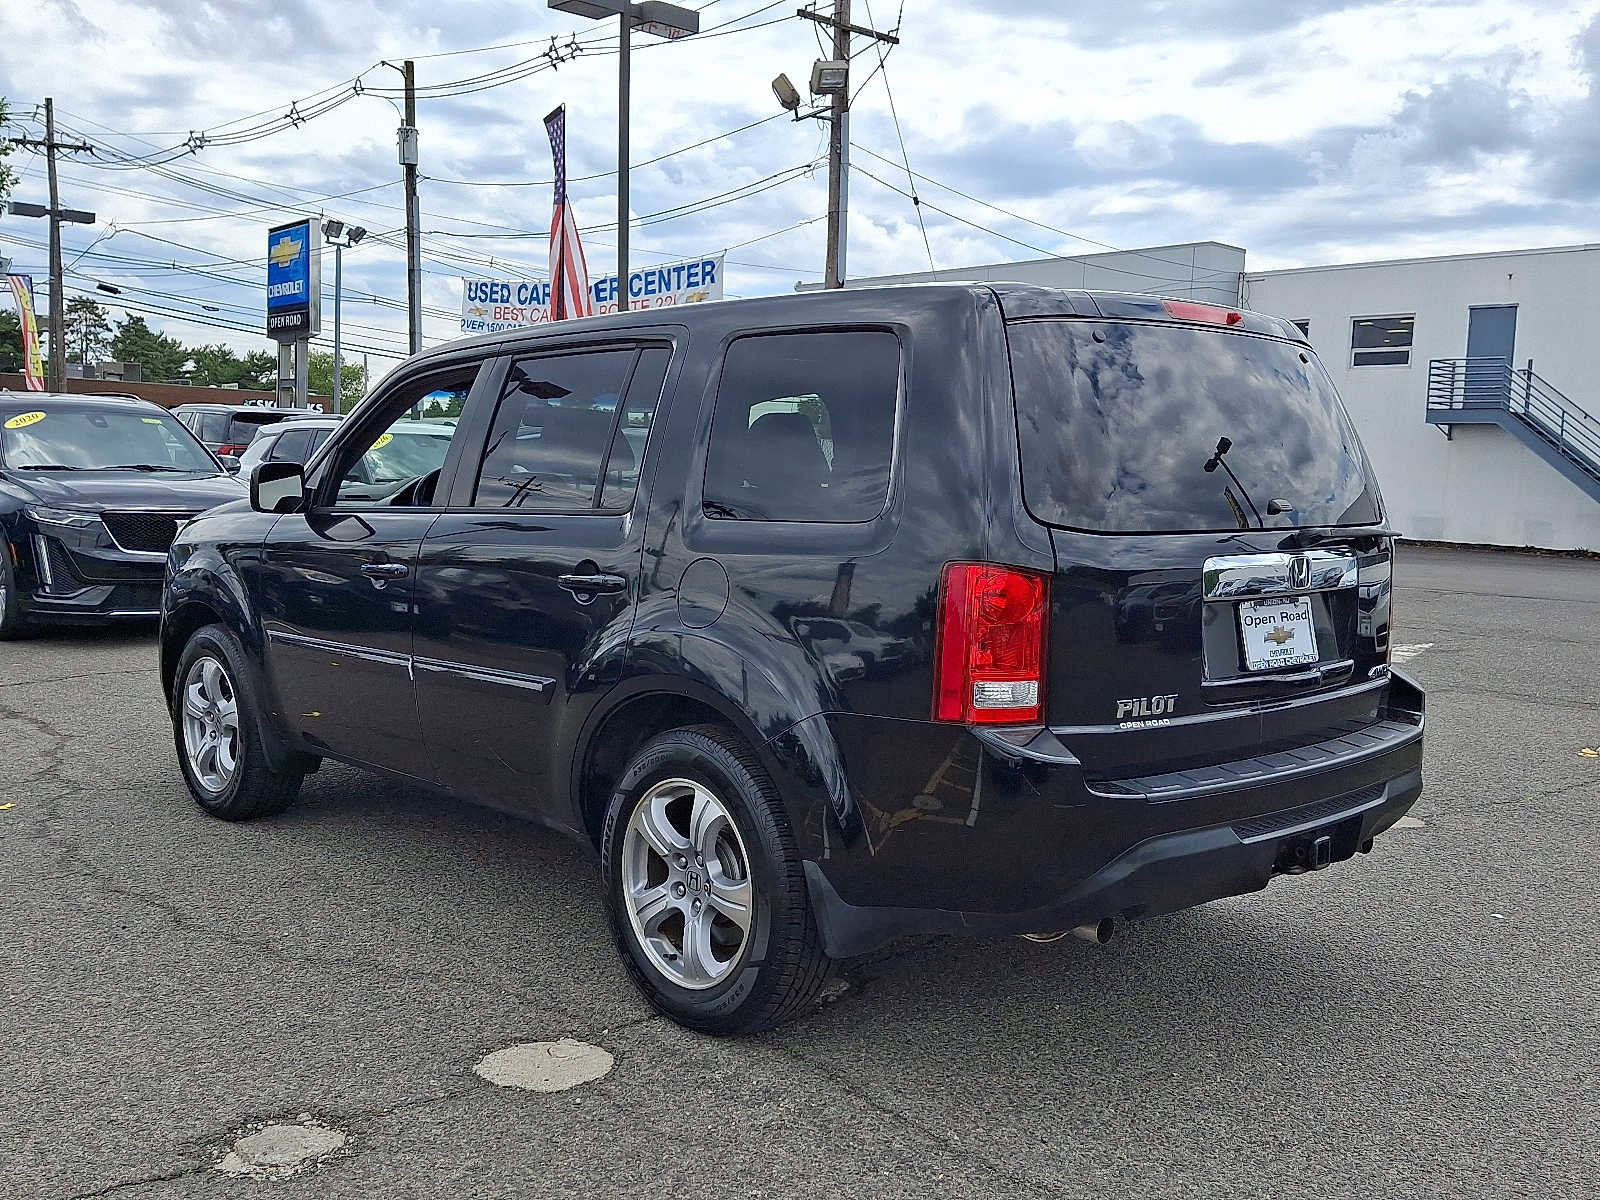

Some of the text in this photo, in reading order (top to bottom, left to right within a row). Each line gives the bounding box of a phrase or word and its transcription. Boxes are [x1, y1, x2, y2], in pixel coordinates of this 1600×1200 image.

[268, 279, 304, 298] CHEVROLET
[468, 281, 511, 303] USED
[629, 260, 716, 298] CENTER
[270, 314, 302, 329] OPEN ROAD
[493, 306, 527, 321] BEST
[15, 413, 39, 426] 2020
[1244, 610, 1308, 628] Open Road
[1116, 694, 1179, 718] PILOT
[1120, 718, 1171, 729] OPEN ROAD
